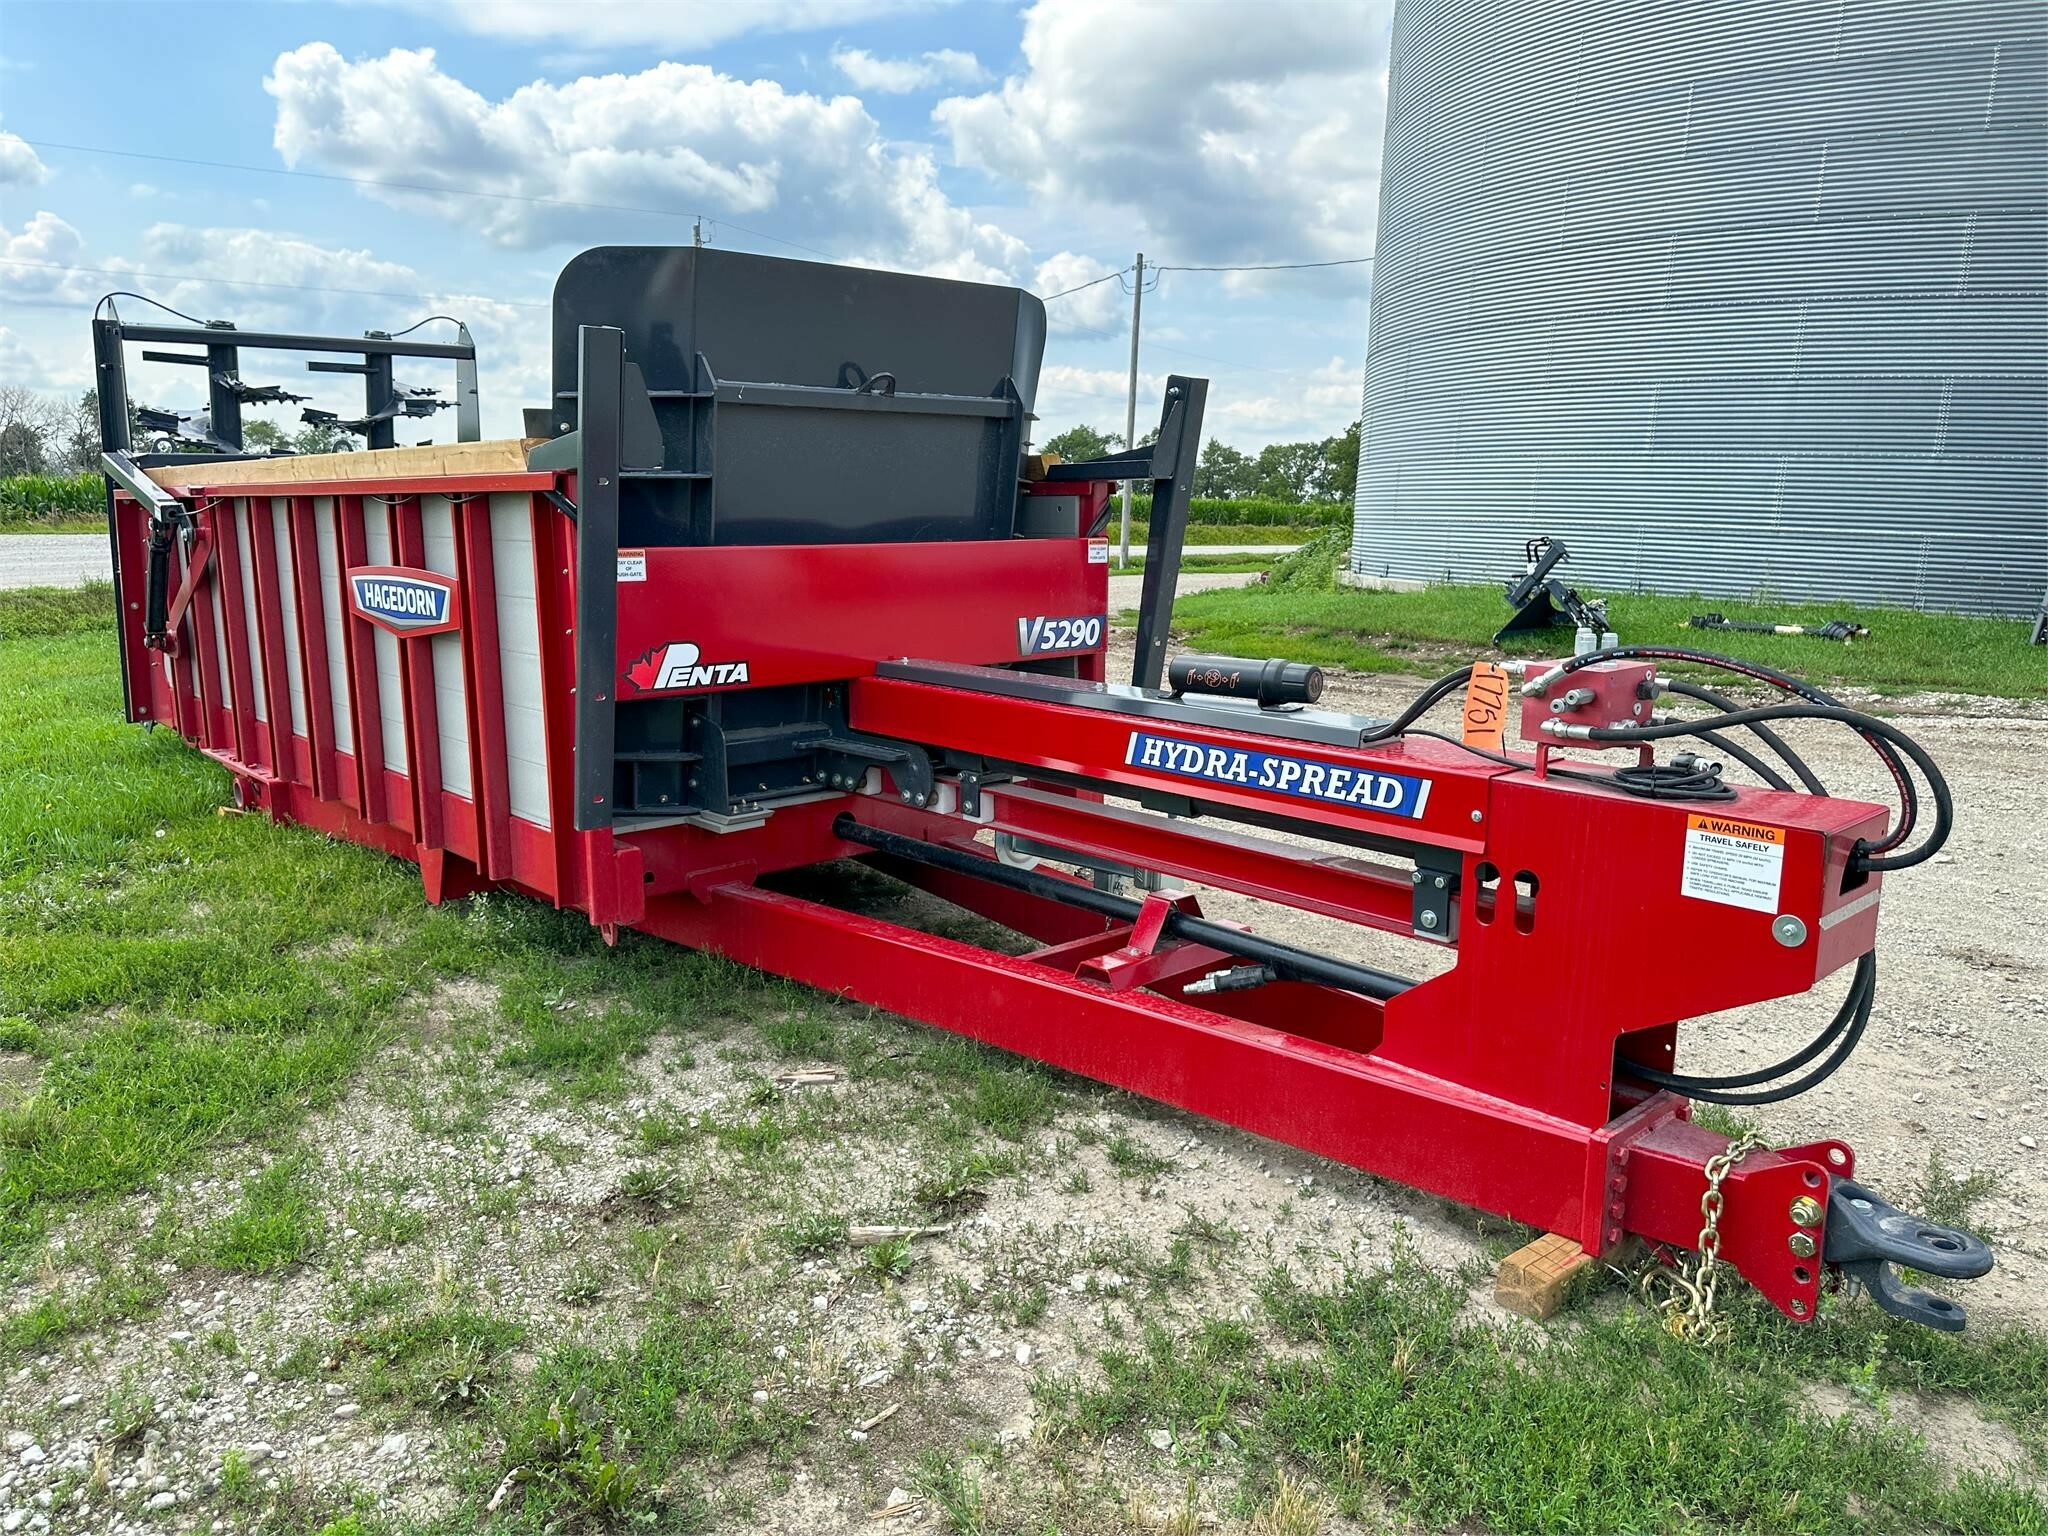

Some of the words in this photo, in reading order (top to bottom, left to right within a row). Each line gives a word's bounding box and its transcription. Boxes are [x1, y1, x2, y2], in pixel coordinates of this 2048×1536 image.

[364, 582, 437, 617] HAGEDORN
[1018, 615, 1101, 657] V5290
[653, 643, 749, 690] PENTA
[1466, 674, 1505, 734] 17751
[1140, 737, 1405, 810] HYDRA-SPREAD
[1700, 833, 1734, 847] TRAVEL
[1735, 840, 1770, 853] SAFELY
[1711, 820, 1776, 841] WARNING
